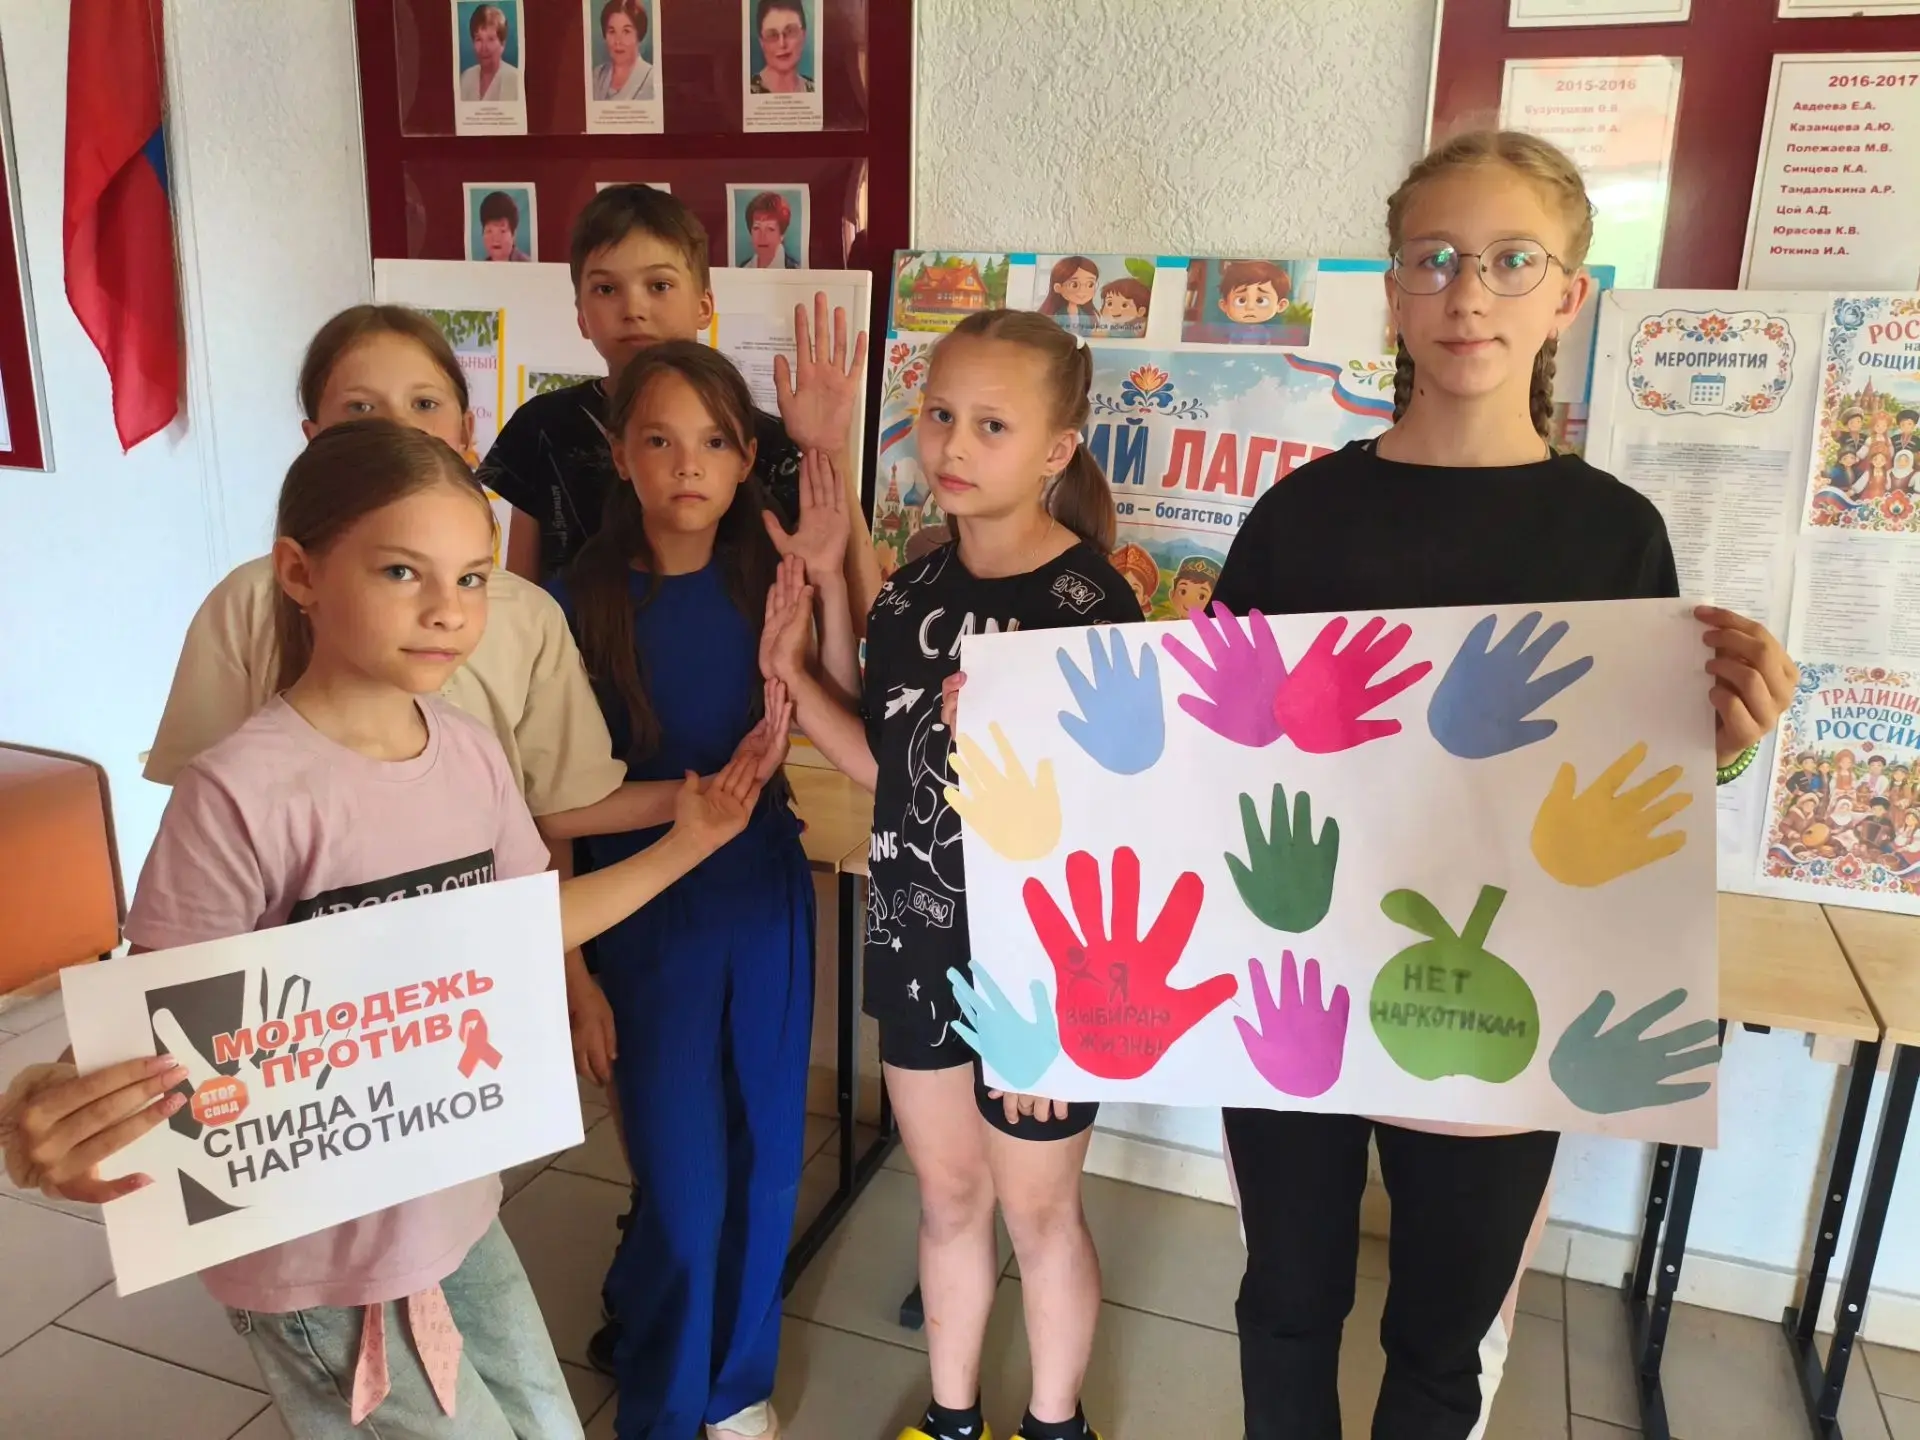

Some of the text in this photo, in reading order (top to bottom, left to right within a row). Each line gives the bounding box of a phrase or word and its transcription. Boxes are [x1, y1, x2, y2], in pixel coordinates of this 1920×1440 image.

[1555, 79, 1637, 92] 2015-2016
[1828, 74, 1919, 88] 2016-2017
[1792, 101, 1876, 112] Авдеева Е.А.
[1790, 122, 1895, 132] Казанцева А.Ю.
[1786, 143, 1892, 153] Полежаева М.В.
[1783, 164, 1867, 174] Синцева К.А.
[1780, 185, 1895, 195] Тандалькина А.Р.
[1776, 205, 1831, 215] Цой А.Д.
[1773, 226, 1860, 236] Юрасова К.В.
[1770, 246, 1850, 255] Юткина И.А.
[1654, 351, 1768, 369] МЕРОПРИЯТИЯ
[1858, 351, 1920, 372] ОБЩИ
[1162, 428, 1338, 498] ЛАГЕ
[1155, 502, 1233, 526] богатство
[1819, 687, 1920, 715] ТРАДИЦИ
[1831, 706, 1913, 726] НАРОДОВ
[1816, 719, 1920, 750] РОССИИ
[1108, 962, 1128, 1003] Я
[1404, 963, 1472, 994] НЕТ
[212, 969, 494, 1064] МОЛОДЕЖЬ
[1067, 1005, 1170, 1026] ВЫБИРАЮ
[1372, 1000, 1527, 1038] НАРКОТИКАМ
[261, 1012, 453, 1088] ПРОТИВ
[203, 1080, 395, 1158] СПИДА И
[204, 1100, 239, 1119] СПИД
[227, 1082, 504, 1187] НАРКОТИКОВ
